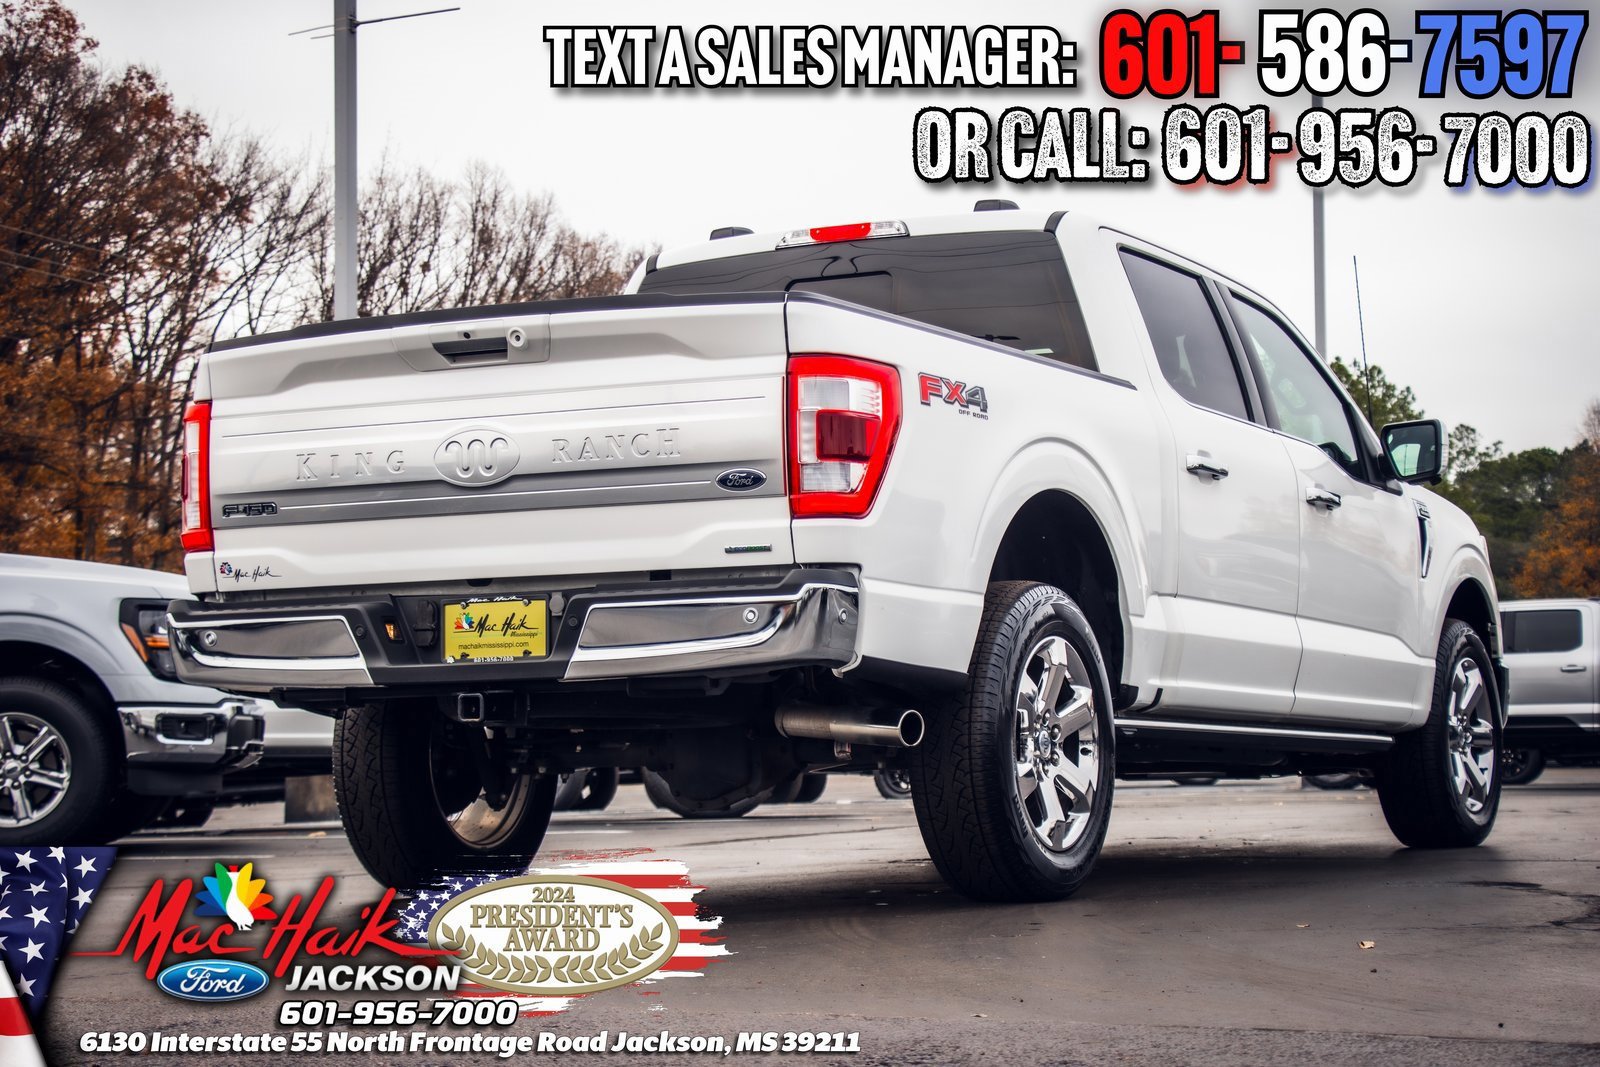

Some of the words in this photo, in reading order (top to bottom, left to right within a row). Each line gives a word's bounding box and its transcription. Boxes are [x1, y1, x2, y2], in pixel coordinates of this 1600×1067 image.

[918, 372, 988, 413] FX4
[296, 450, 406, 482] KING
[551, 427, 681, 464] RANCH
[233, 568, 251, 583] Mac
[252, 565, 282, 582] Haik
[473, 613, 500, 638] Mac
[501, 612, 539, 637] Haik
[458, 640, 530, 651] machaikmississippi.com
